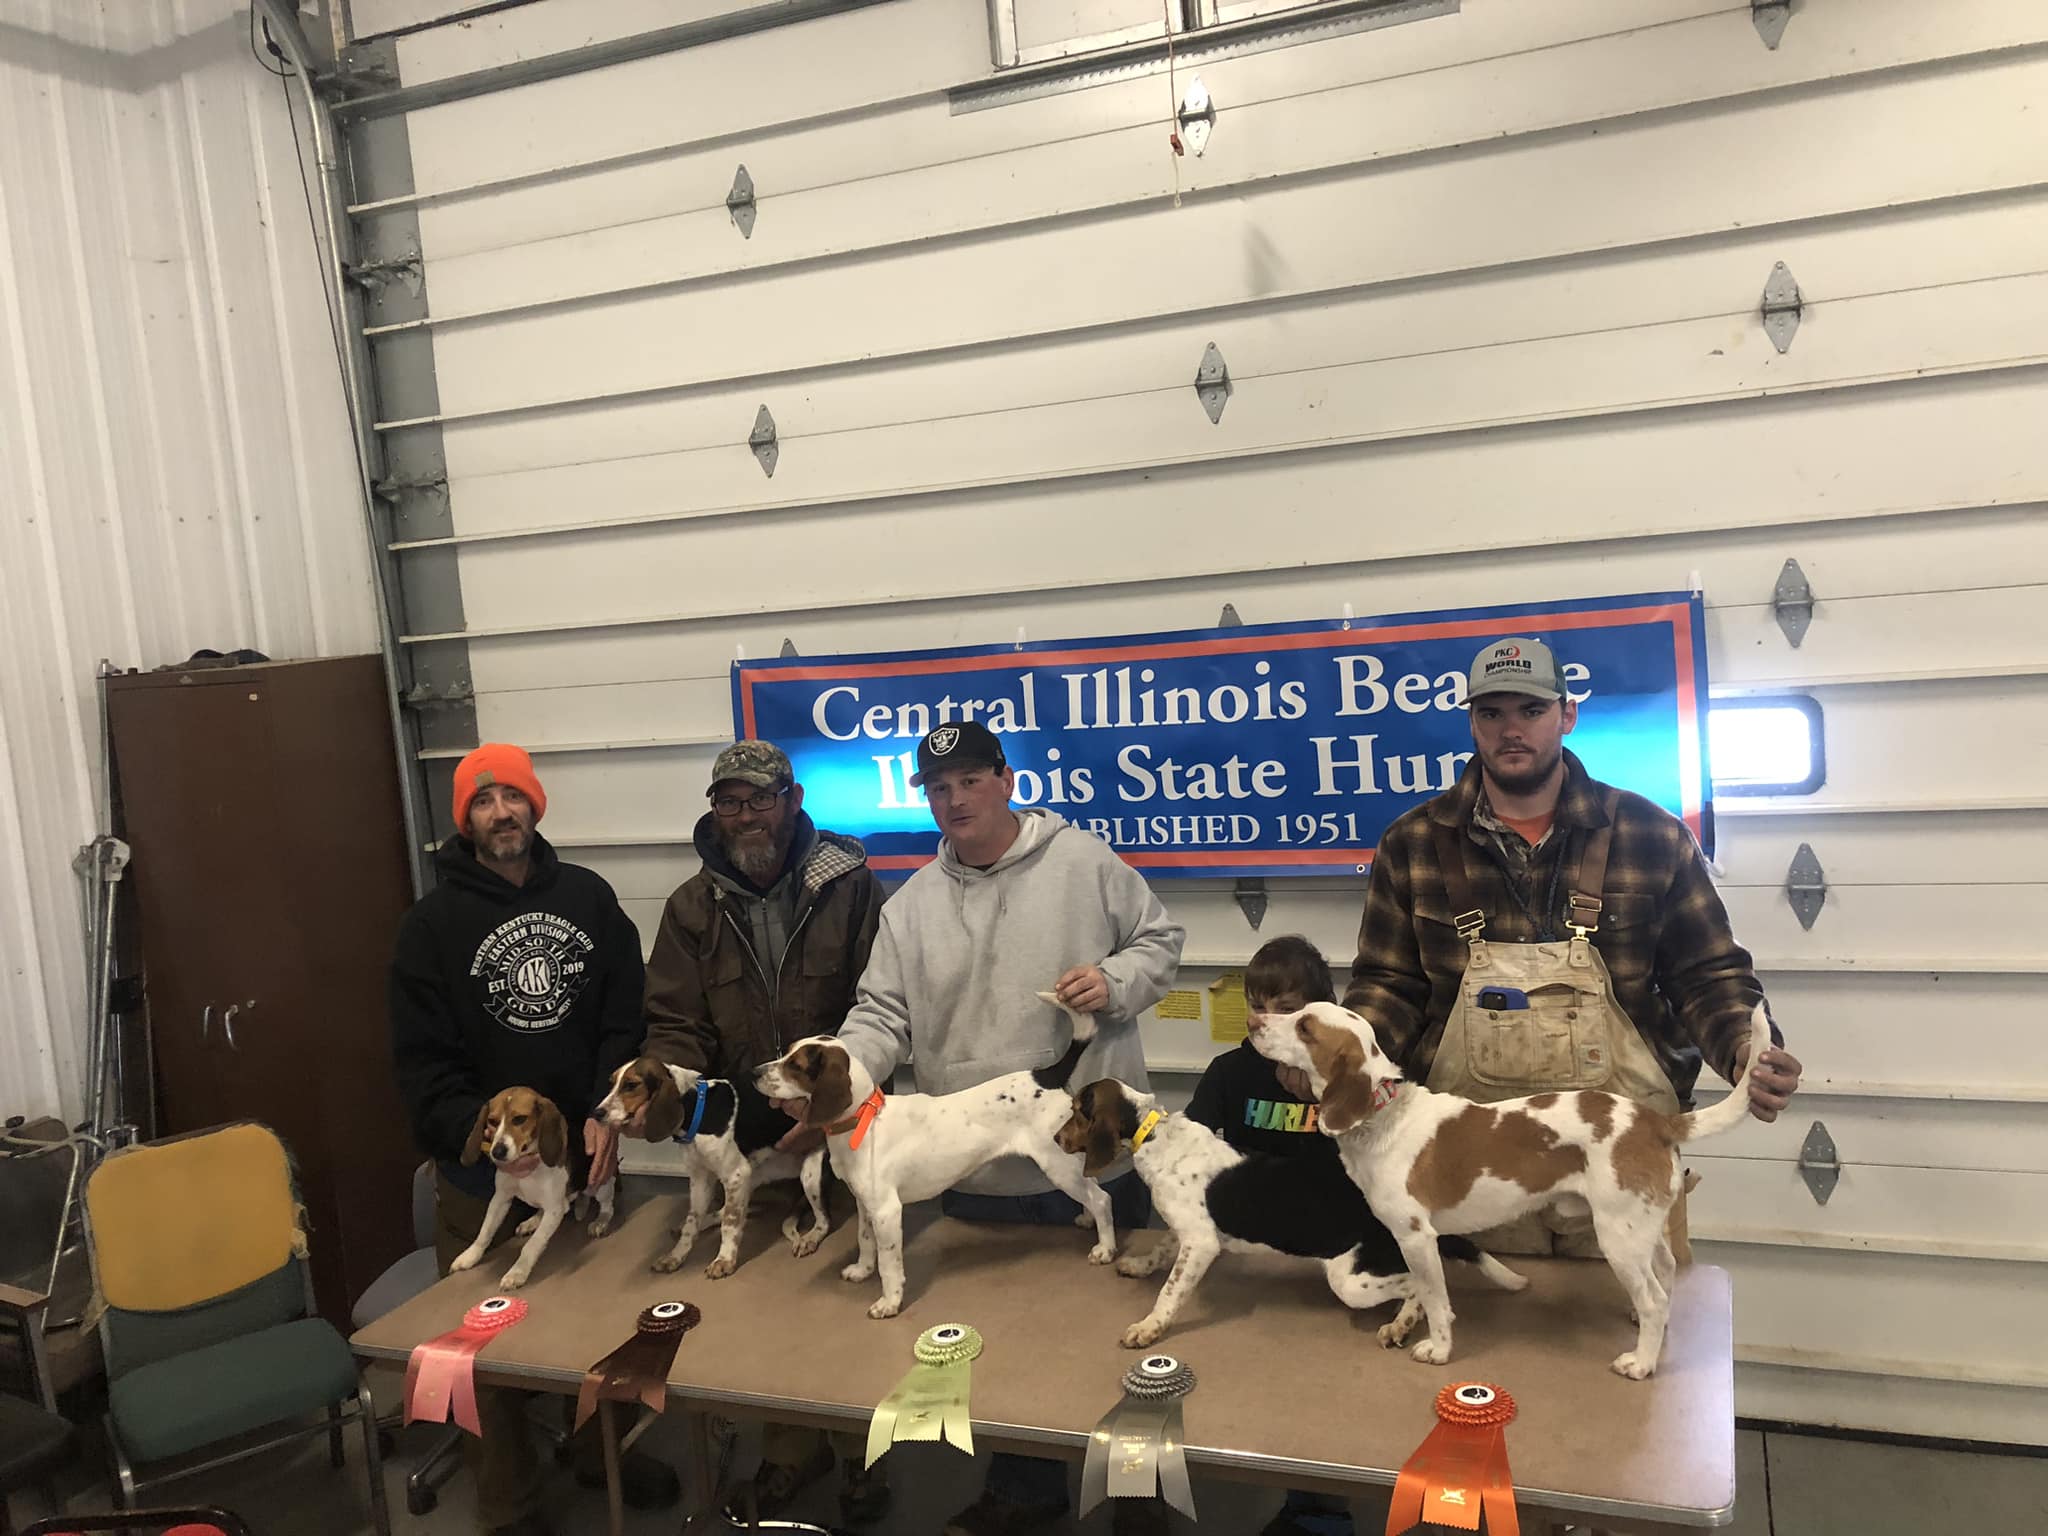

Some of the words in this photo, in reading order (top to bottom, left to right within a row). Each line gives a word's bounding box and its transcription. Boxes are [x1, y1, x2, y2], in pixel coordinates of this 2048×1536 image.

[1485, 660, 1532, 672] WORLD
[1494, 647, 1514, 658] PKC
[812, 672, 1040, 741] Central
[1061, 661, 1307, 732] Illinois
[1333, 639, 1592, 718] Beae
[872, 748, 1094, 809] Ilois
[1117, 744, 1287, 803] State
[1309, 734, 1475, 796] Hun
[1068, 814, 1260, 846] BLISHED
[1277, 812, 1362, 845] 1951
[469, 932, 498, 976] WESTERN
[495, 912, 544, 936] KENTUCKY
[544, 913, 578, 935] BEAGLE
[575, 930, 595, 951] CLUB
[487, 926, 528, 962] EASTERN
[530, 923, 570, 943] DIVISION
[562, 960, 585, 976] 2019
[487, 978, 509, 994] EST.
[1244, 1098, 1320, 1133] HURLE
